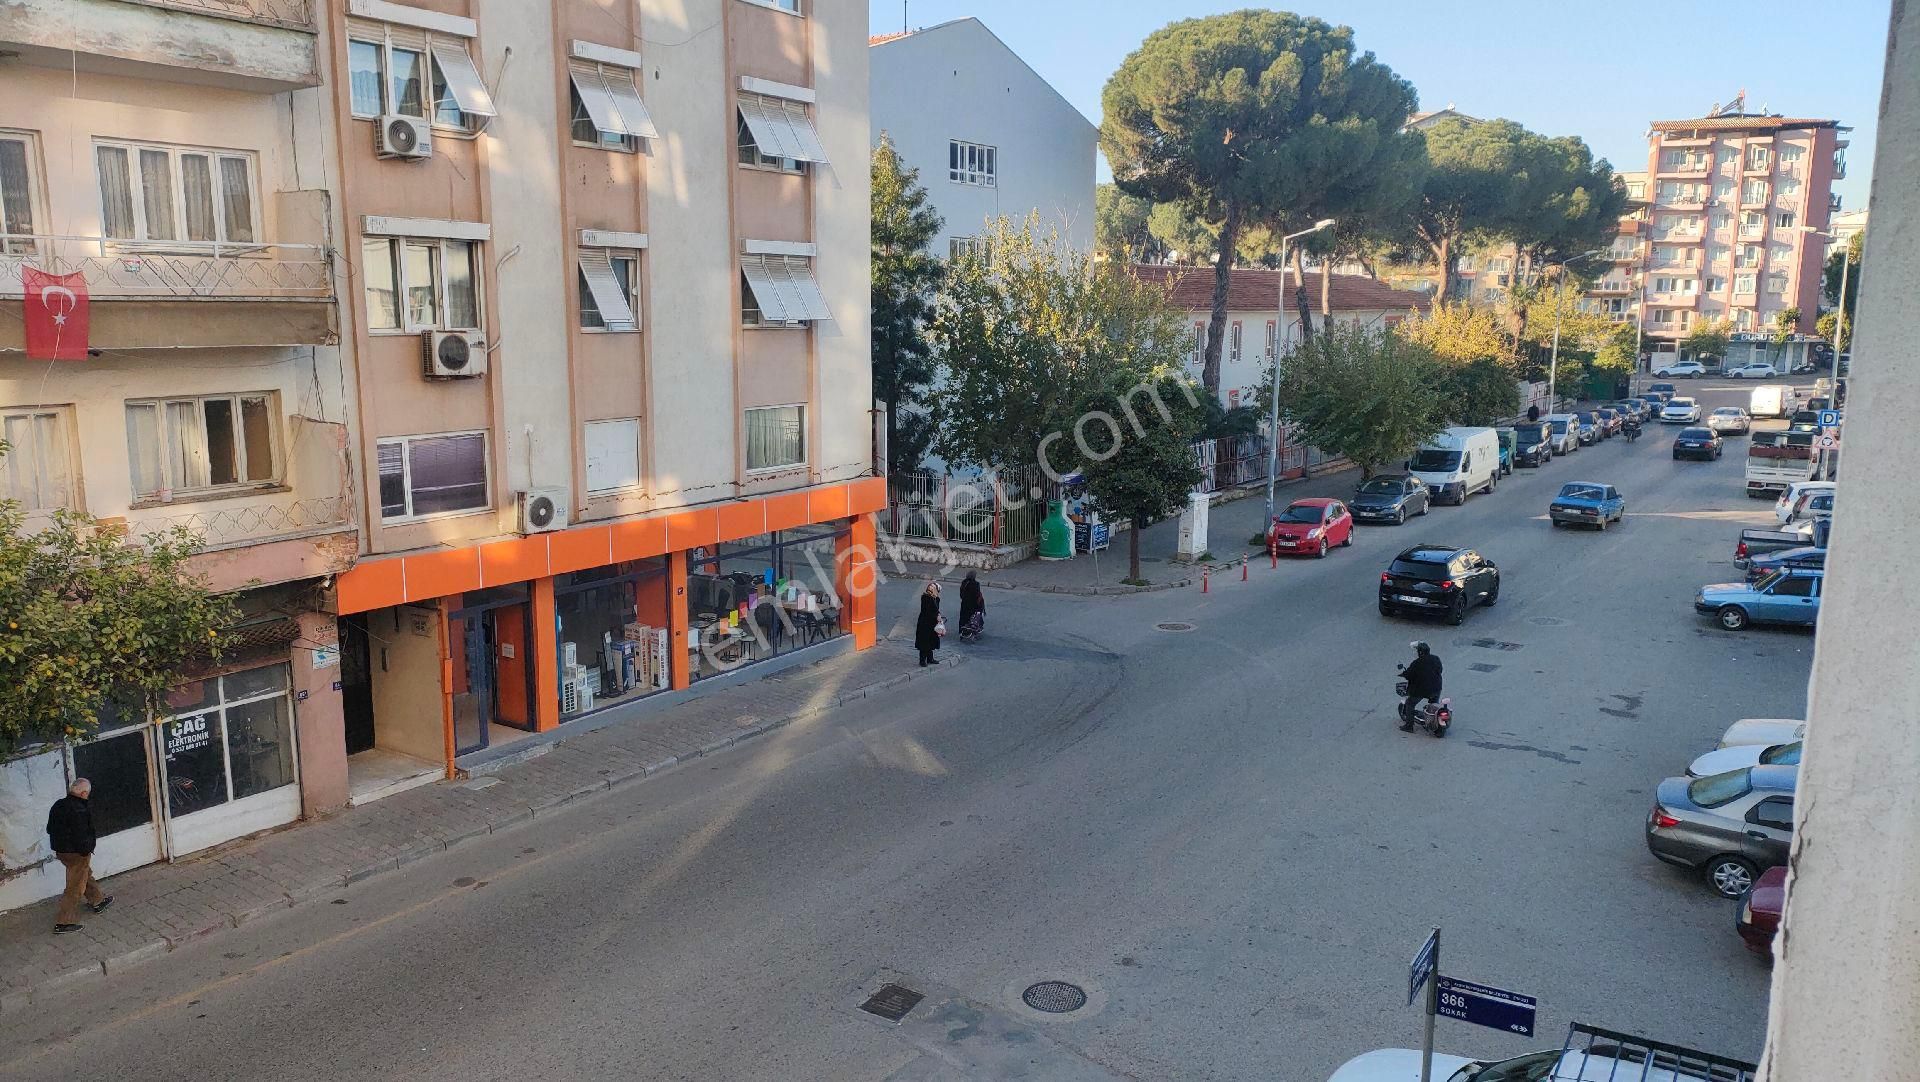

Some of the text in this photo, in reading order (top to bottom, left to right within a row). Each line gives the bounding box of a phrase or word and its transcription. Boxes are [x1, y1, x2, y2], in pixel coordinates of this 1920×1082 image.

[171, 714, 206, 739] ÇAĞ
[168, 730, 210, 749] ELEKTRONİK
[1441, 992, 1469, 1010] 366.
[1440, 1006, 1467, 1019] SOKAK
